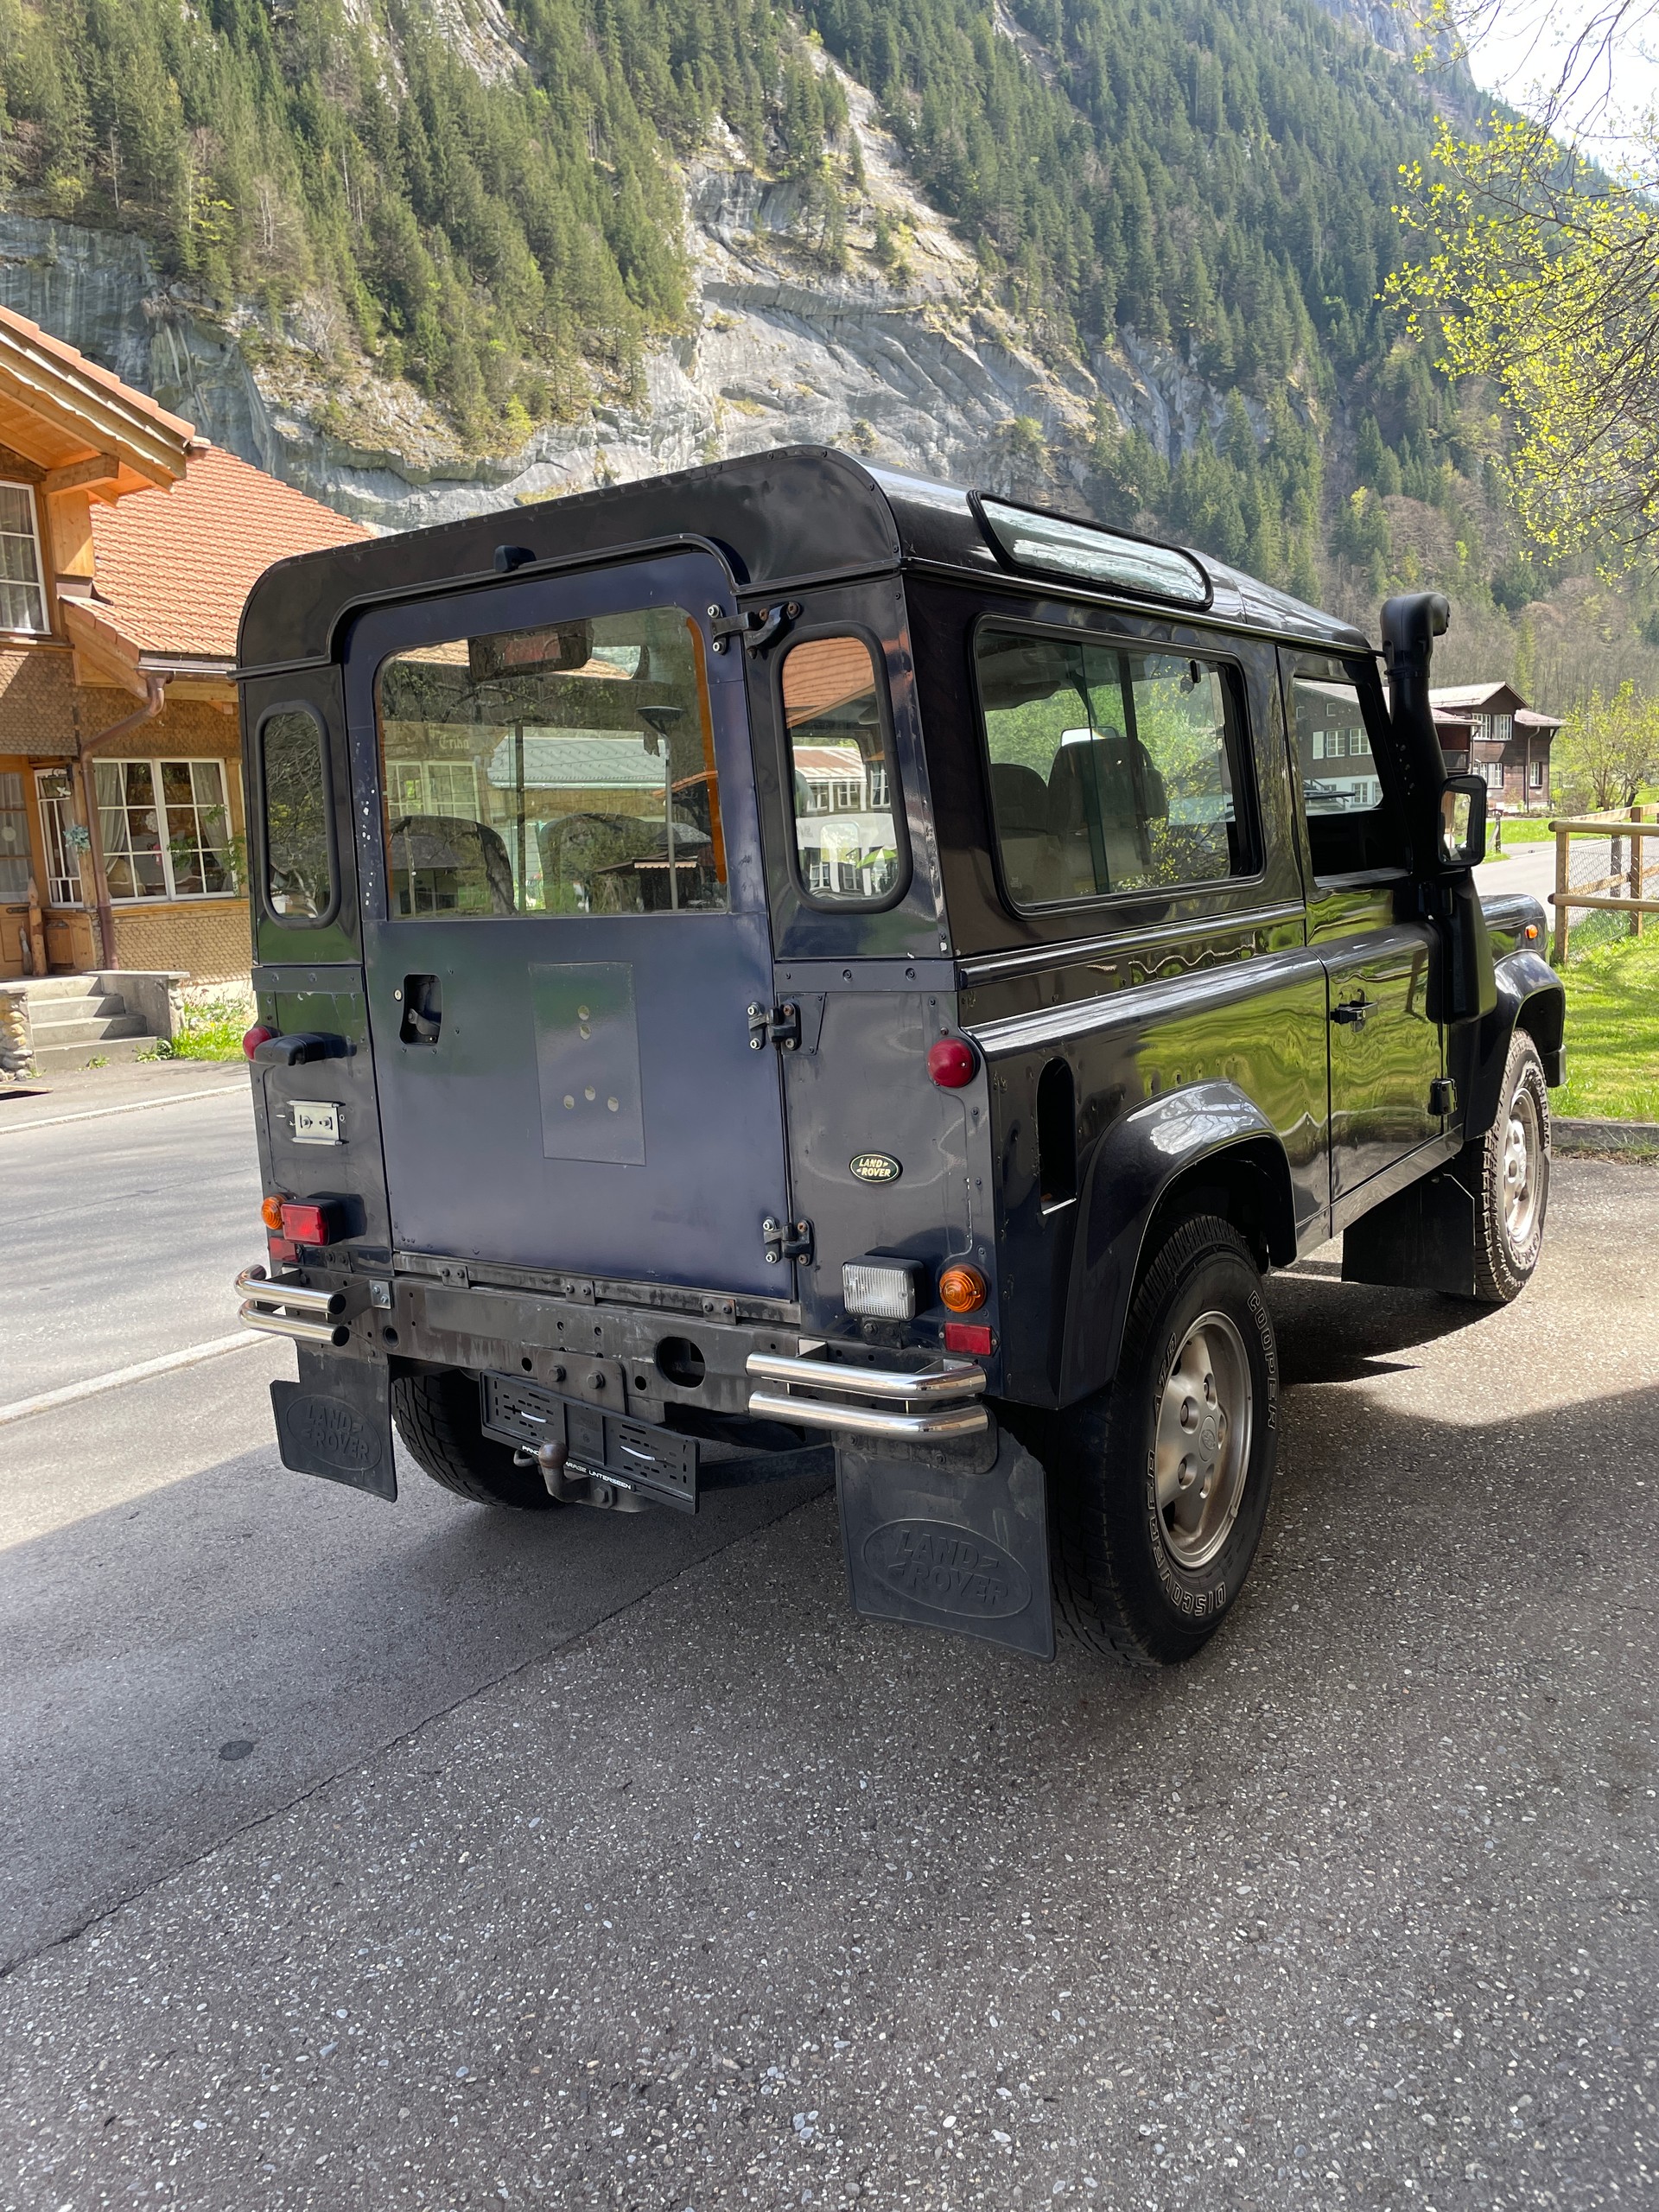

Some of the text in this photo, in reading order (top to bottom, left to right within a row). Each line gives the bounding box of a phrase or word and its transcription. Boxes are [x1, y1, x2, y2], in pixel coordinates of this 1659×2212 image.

[858, 1158, 883, 1168] LAND
[861, 1167, 891, 1177] ROVER
[1247, 1290, 1277, 1430] COOPER
[308, 1404, 353, 1432] LAND
[314, 1428, 370, 1461] ROVER
[588, 1470, 632, 1491] UNTERSEEN
[896, 1529, 979, 1570] LAND
[910, 1560, 1009, 1605] ROVER
